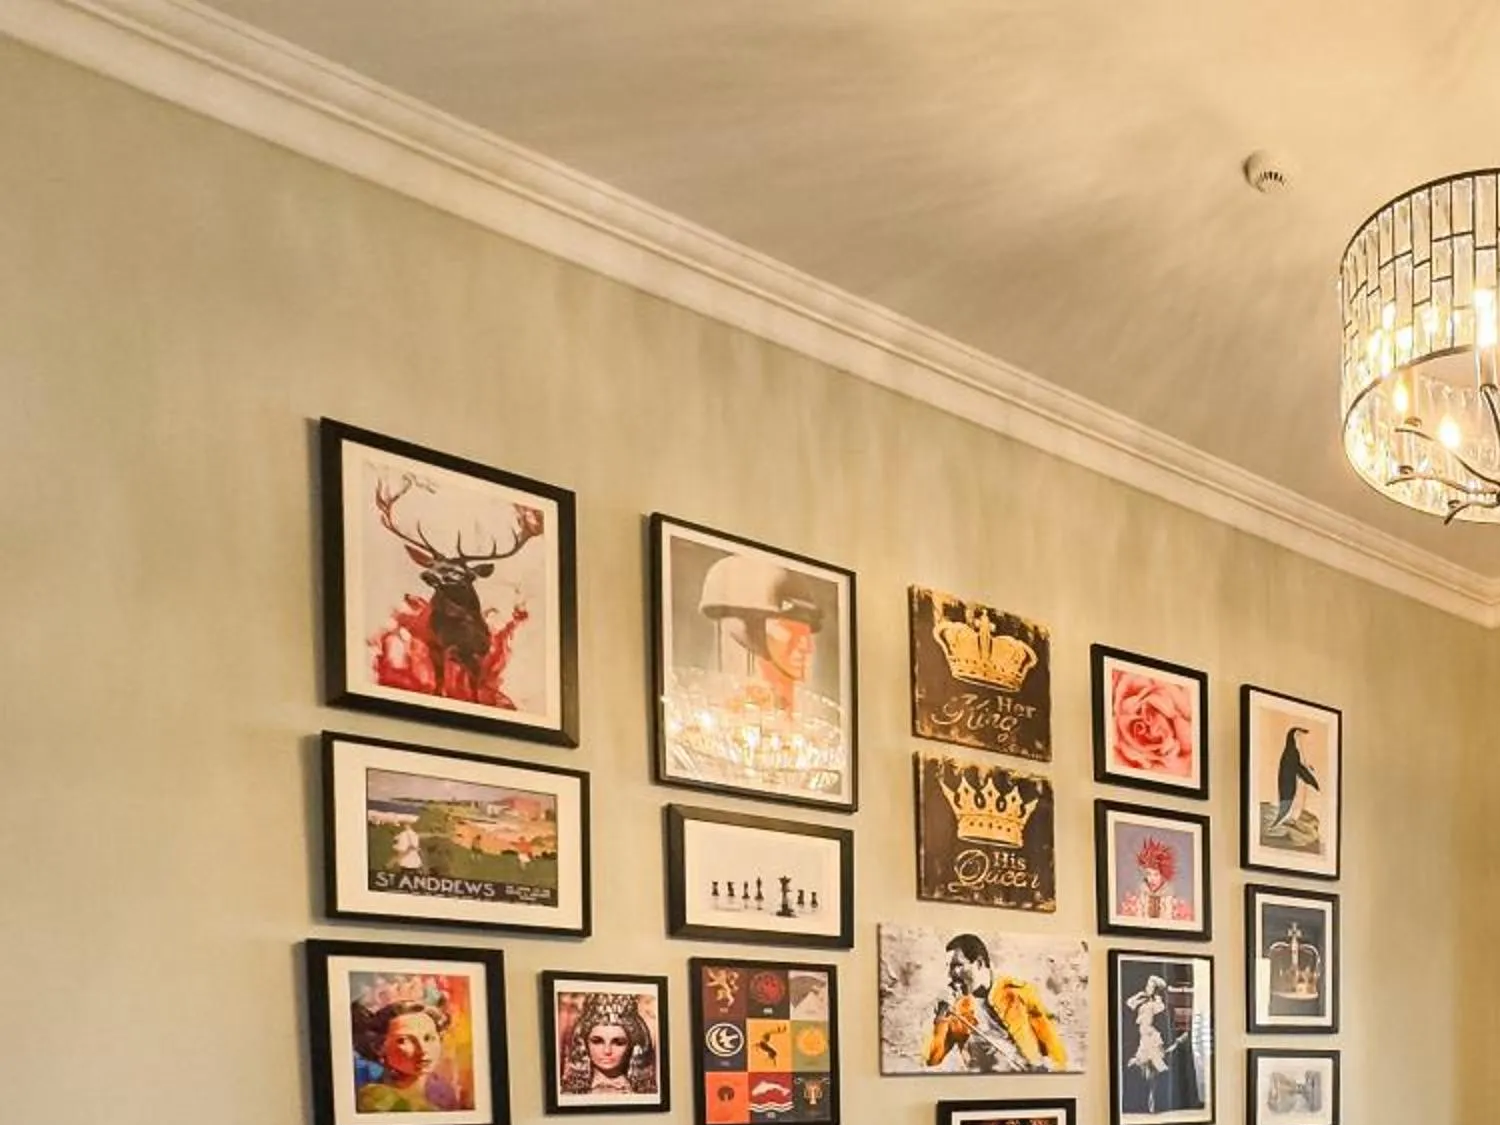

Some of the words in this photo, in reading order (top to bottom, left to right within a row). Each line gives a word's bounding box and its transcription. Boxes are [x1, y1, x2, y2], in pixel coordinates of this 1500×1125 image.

[997, 695, 1037, 719] Her
[992, 851, 1027, 871] His
[400, 876, 495, 897] ANDREWS
